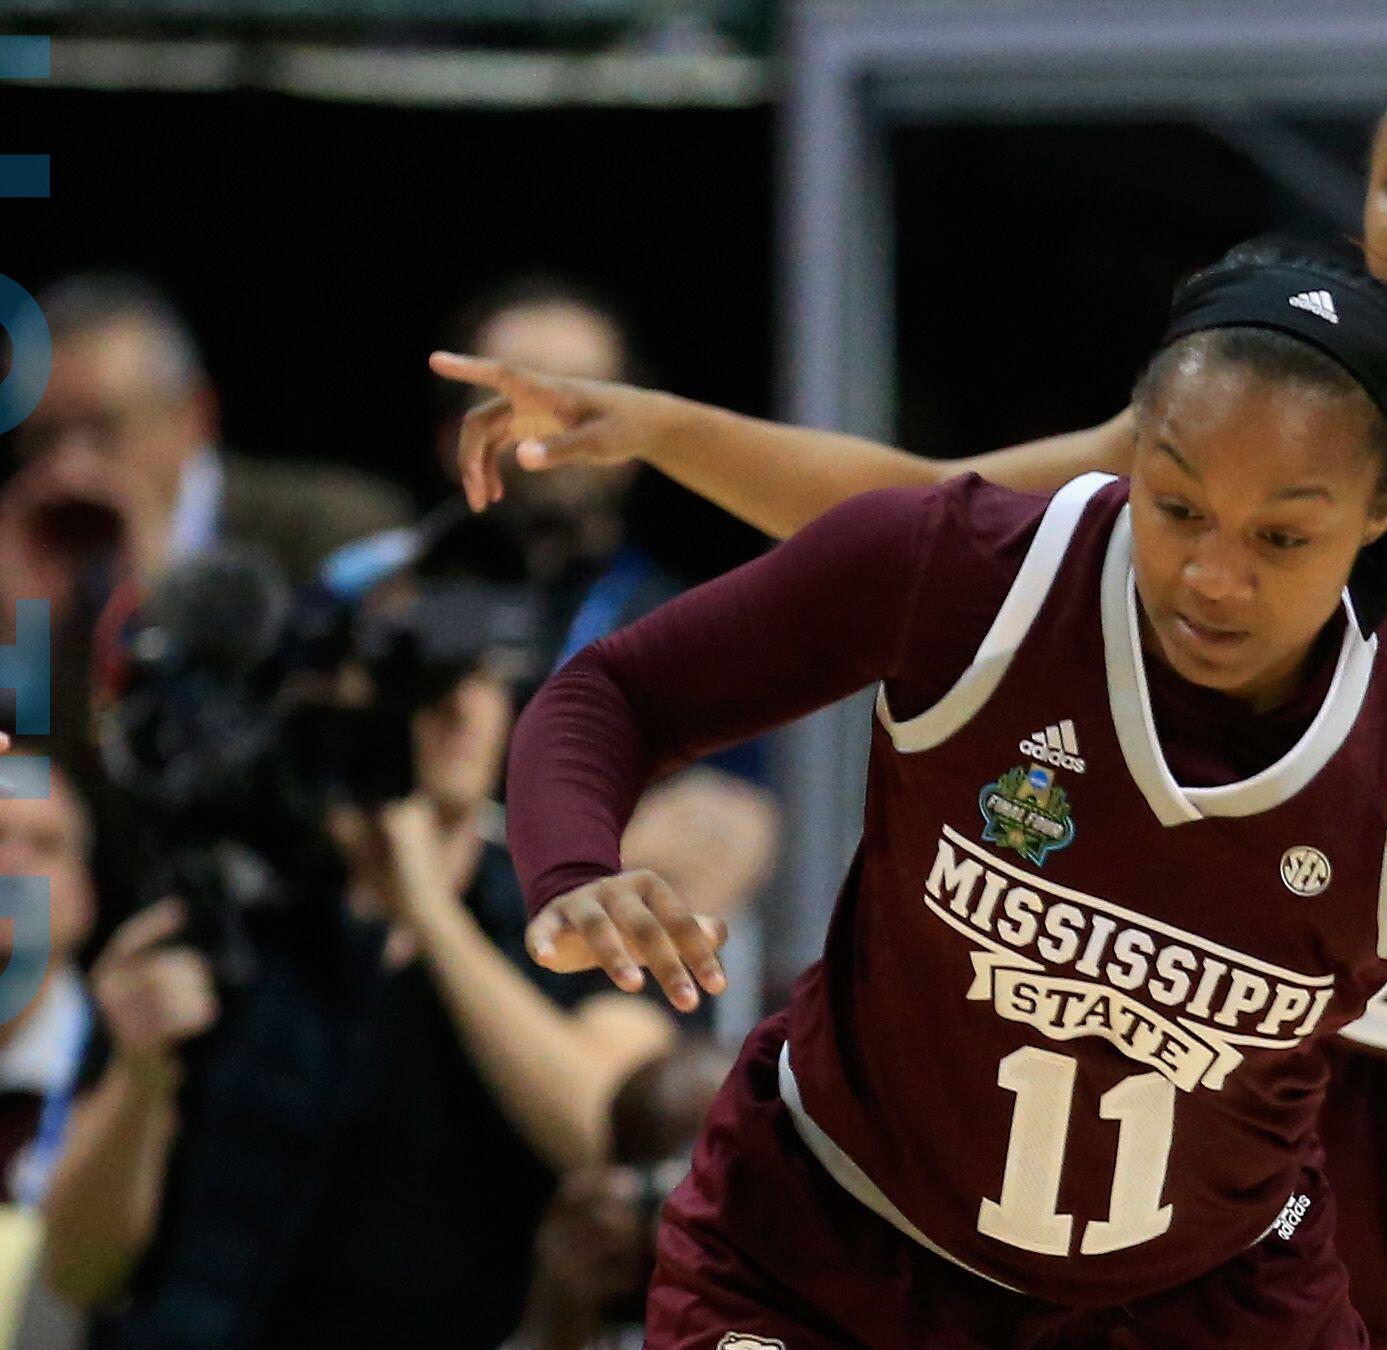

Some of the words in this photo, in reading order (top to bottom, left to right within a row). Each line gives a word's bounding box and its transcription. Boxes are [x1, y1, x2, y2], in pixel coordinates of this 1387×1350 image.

[1019, 739, 1086, 774] adidas
[1281, 848, 1328, 893] SEC
[925, 839, 1334, 1036] MISSISSIPPI
[1011, 982, 1190, 1074] STATE
[976, 1045, 1176, 1257] 11
[1278, 1195, 1311, 1240] adidas
